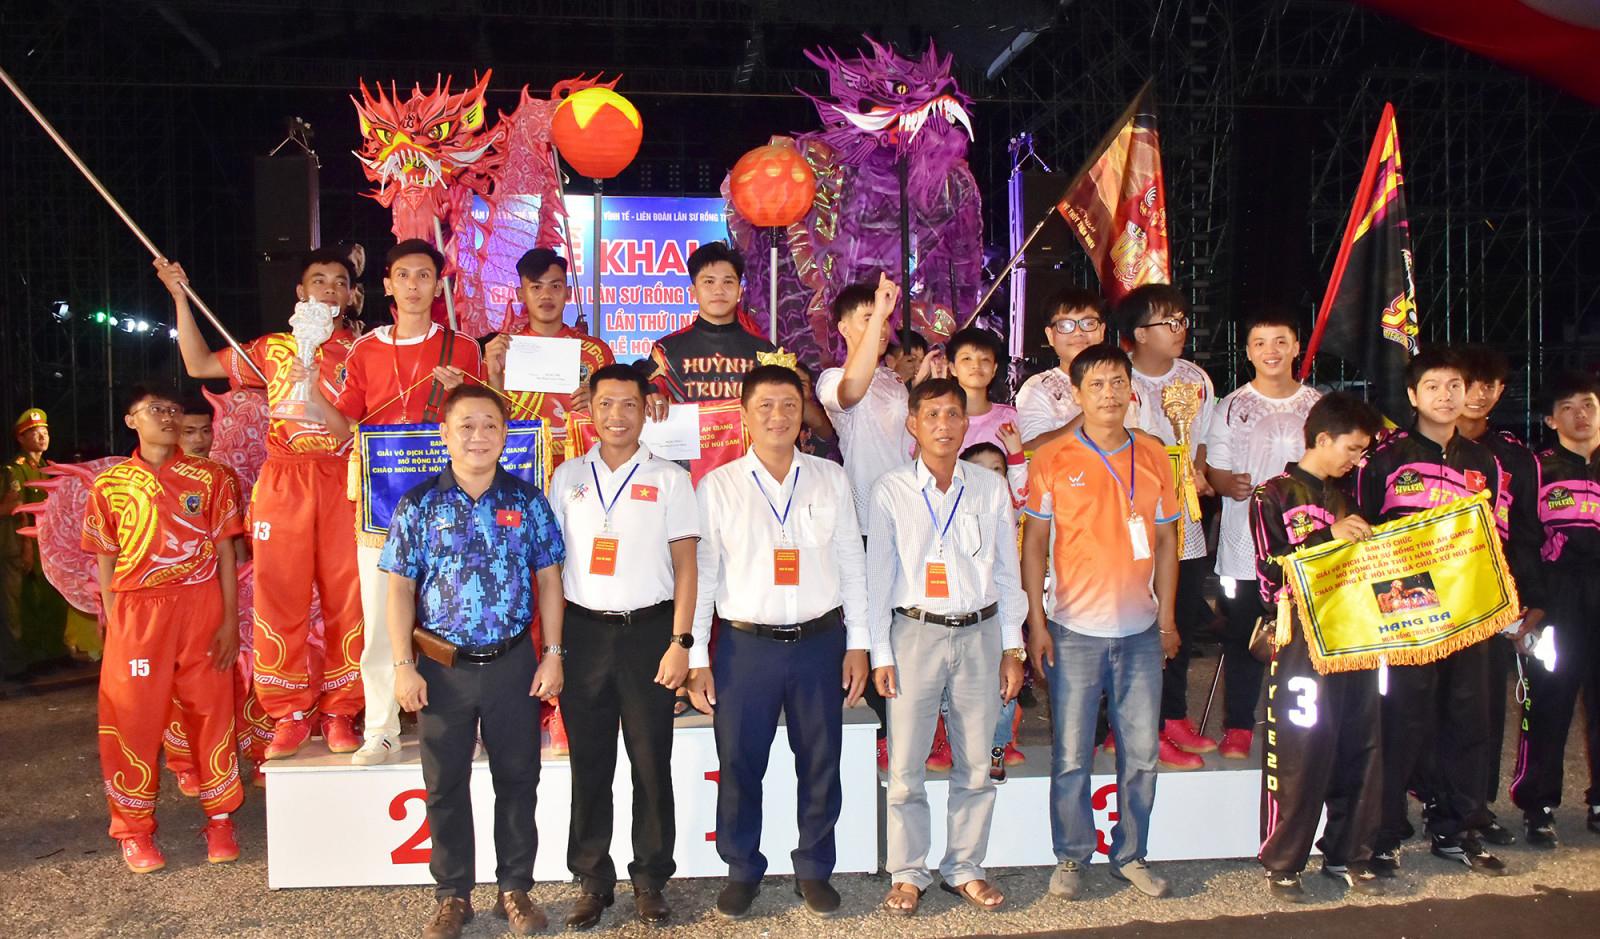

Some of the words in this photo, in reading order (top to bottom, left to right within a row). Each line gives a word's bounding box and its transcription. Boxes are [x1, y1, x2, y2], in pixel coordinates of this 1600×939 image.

[622, 209, 631, 221] TẾ
[636, 209, 652, 221] LIÊN
[653, 209, 672, 221] ĐOÀN
[674, 209, 688, 222] LÂN
[689, 211, 699, 222] SƯ
[700, 210, 719, 222] RỒNG
[490, 281, 521, 305] GIẢ
[620, 285, 642, 305] SƯ
[643, 282, 685, 305] RỒNG
[606, 308, 636, 332] LẦN
[638, 311, 670, 332] THỨ
[670, 313, 676, 331] I
[679, 310, 700, 329] NĂ
[610, 335, 628, 356] LỄ
[630, 337, 656, 359] HỘ
[683, 352, 754, 374] HUỲNH
[684, 381, 744, 398] TRUN
[376, 448, 392, 456] GIẢI
[418, 464, 427, 472] LỄ
[252, 520, 271, 541] 13
[1450, 528, 1474, 540] GIANG
[1393, 536, 1414, 546] CHỨC
[1428, 611, 1452, 623] BA
[128, 658, 150, 676] 15
[1287, 676, 1318, 728] 3
[388, 788, 432, 864] 2
